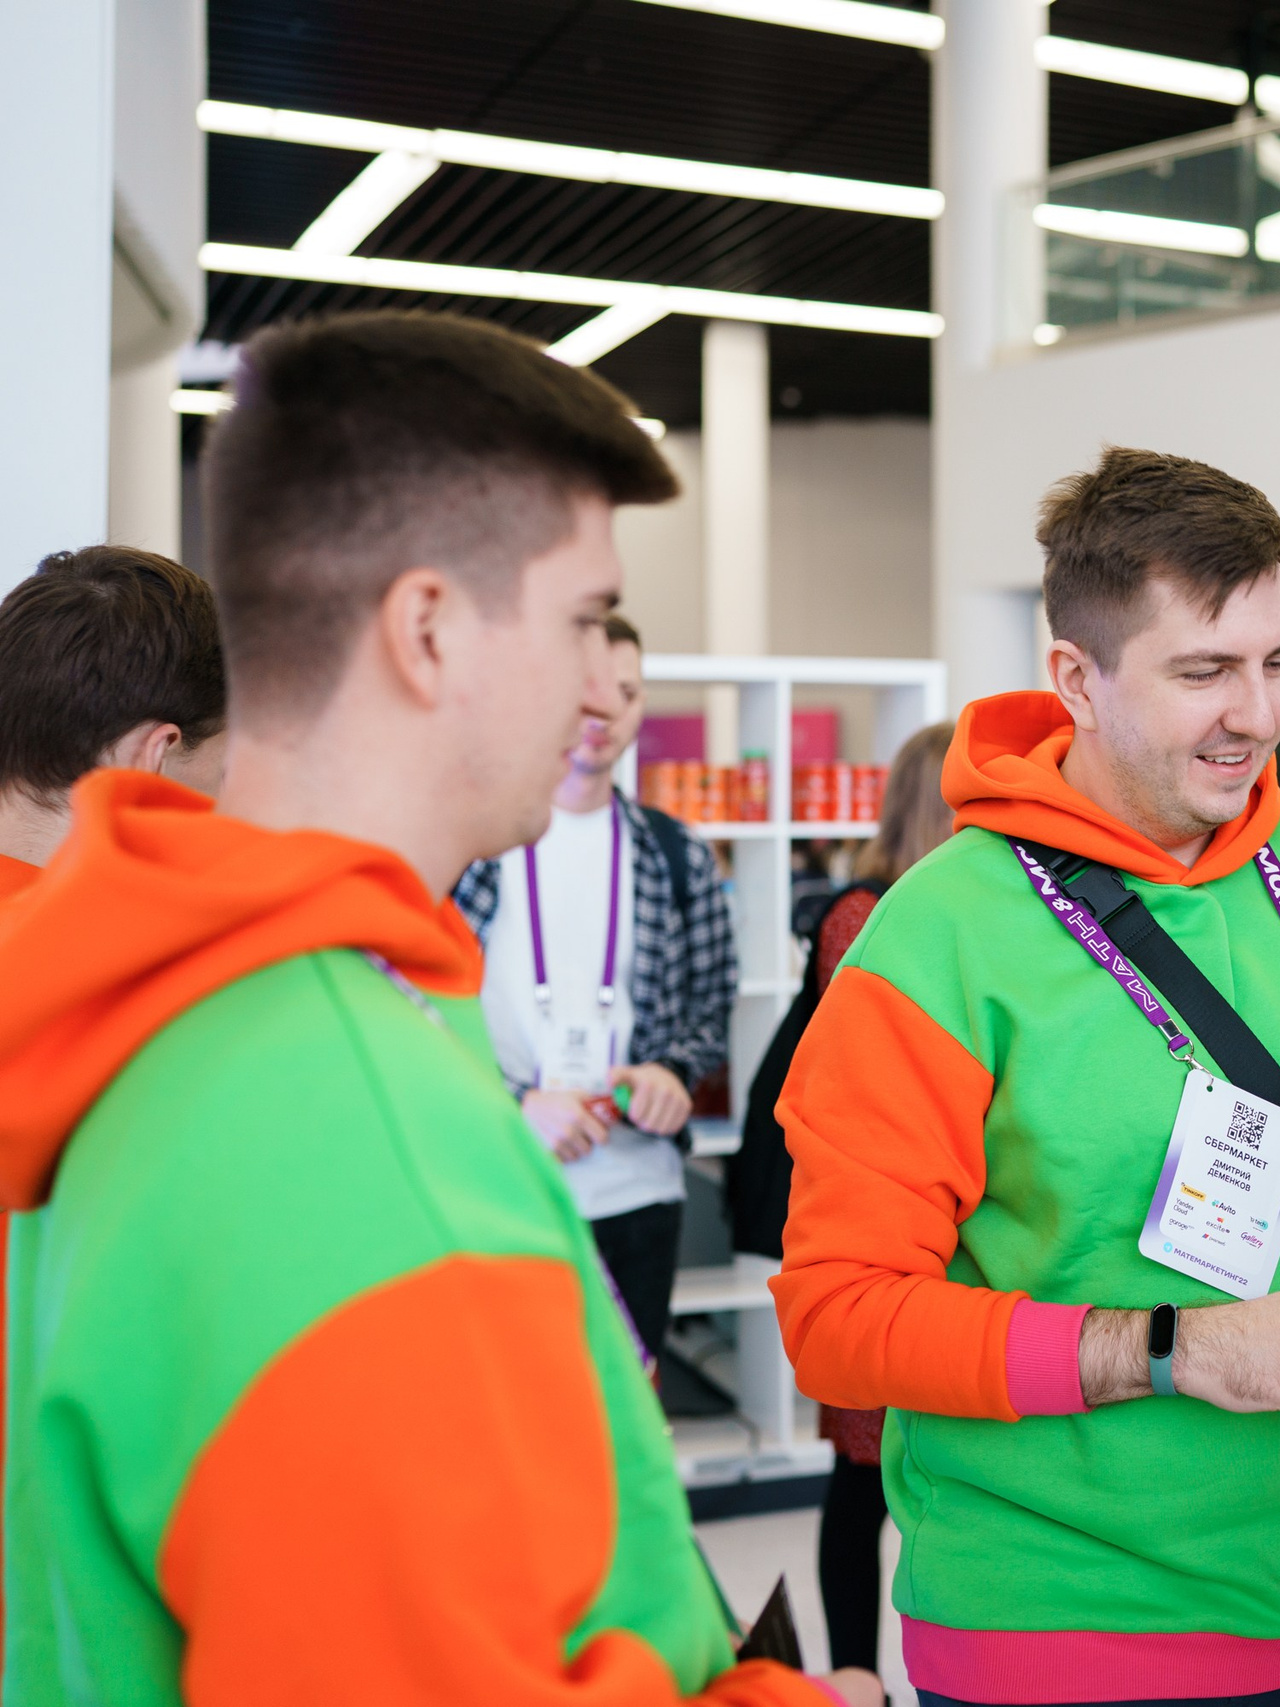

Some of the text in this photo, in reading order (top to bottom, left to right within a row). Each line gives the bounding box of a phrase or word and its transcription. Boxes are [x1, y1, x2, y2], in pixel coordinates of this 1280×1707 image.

[1067, 911, 1159, 1013] MATH
[1204, 1135, 1269, 1171] СБЕРМАРКЕТ
[1207, 1167, 1251, 1192] ДЕМЕНКОВ
[1212, 1159, 1251, 1181] ДМИТРИЙ
[1173, 1204, 1188, 1216] Cloud
[1176, 1198, 1194, 1211] Yandex
[1219, 1202, 1236, 1215] Avito
[1240, 1232, 1264, 1249] Gallery
[1173, 1248, 1249, 1286] МАТЕМАРКЕТИНГ22
